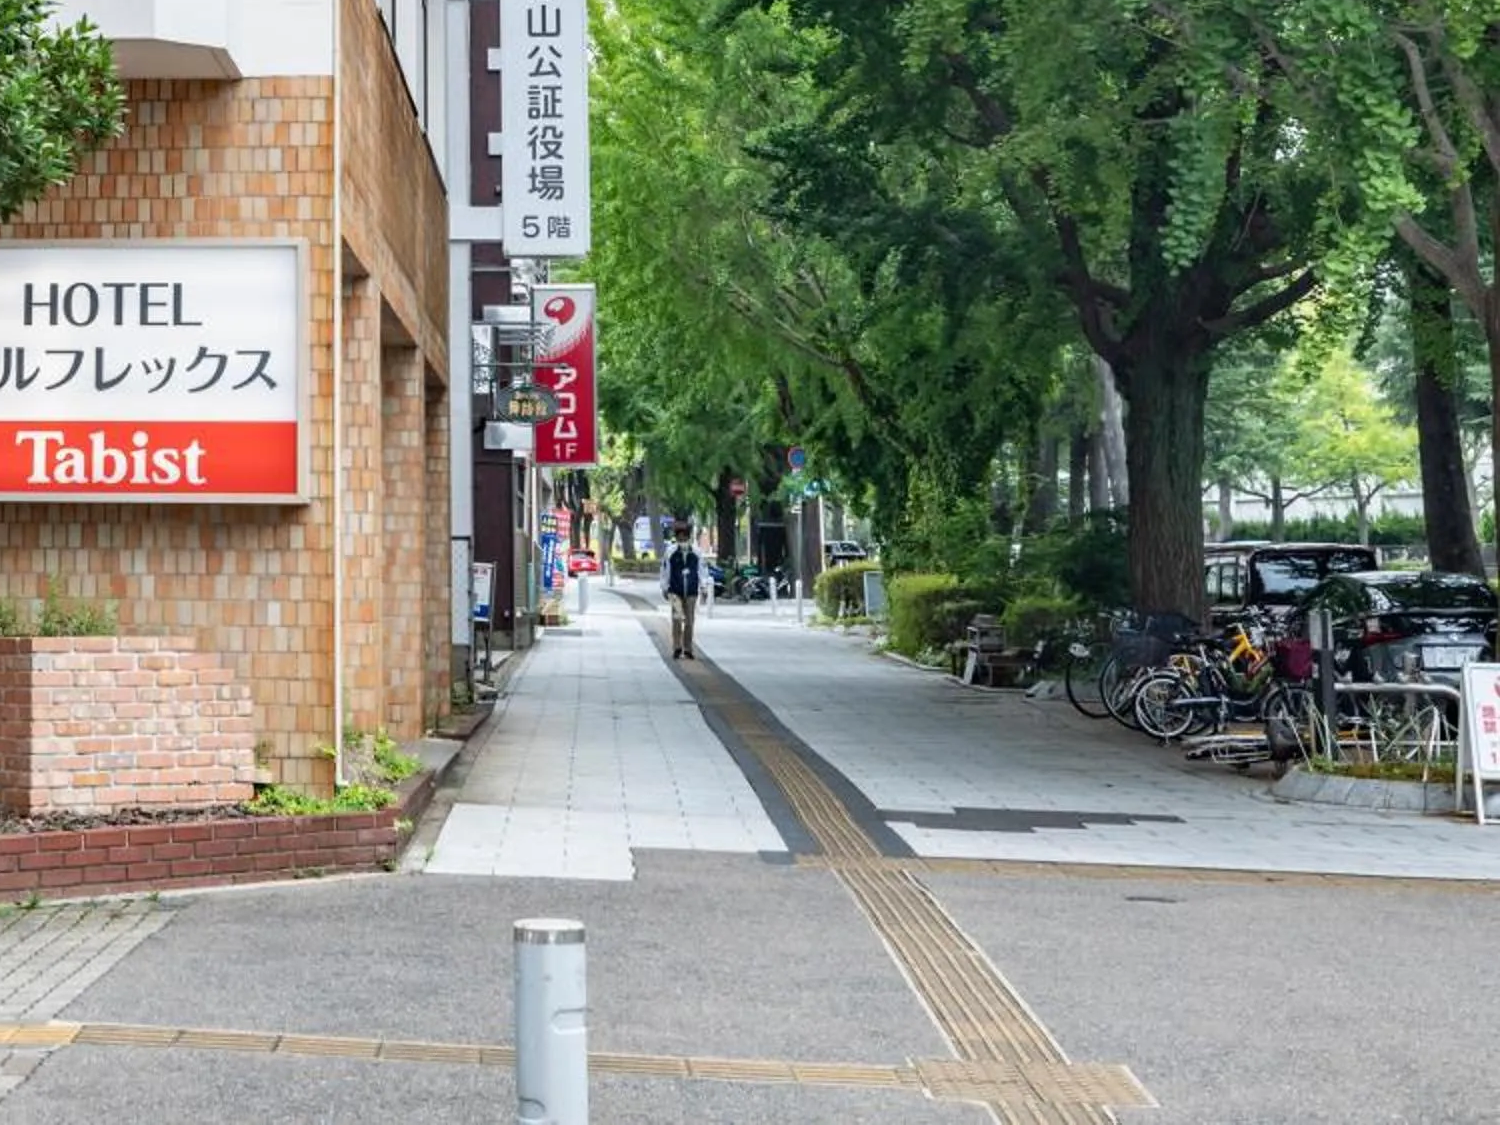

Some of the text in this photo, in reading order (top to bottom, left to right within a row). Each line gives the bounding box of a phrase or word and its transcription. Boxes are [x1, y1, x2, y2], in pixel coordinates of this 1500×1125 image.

[22, 281, 203, 327] HOTEL
[553, 366, 577, 439] アコム
[14, 429, 207, 486] Tabist
[553, 442, 577, 460] 1F
